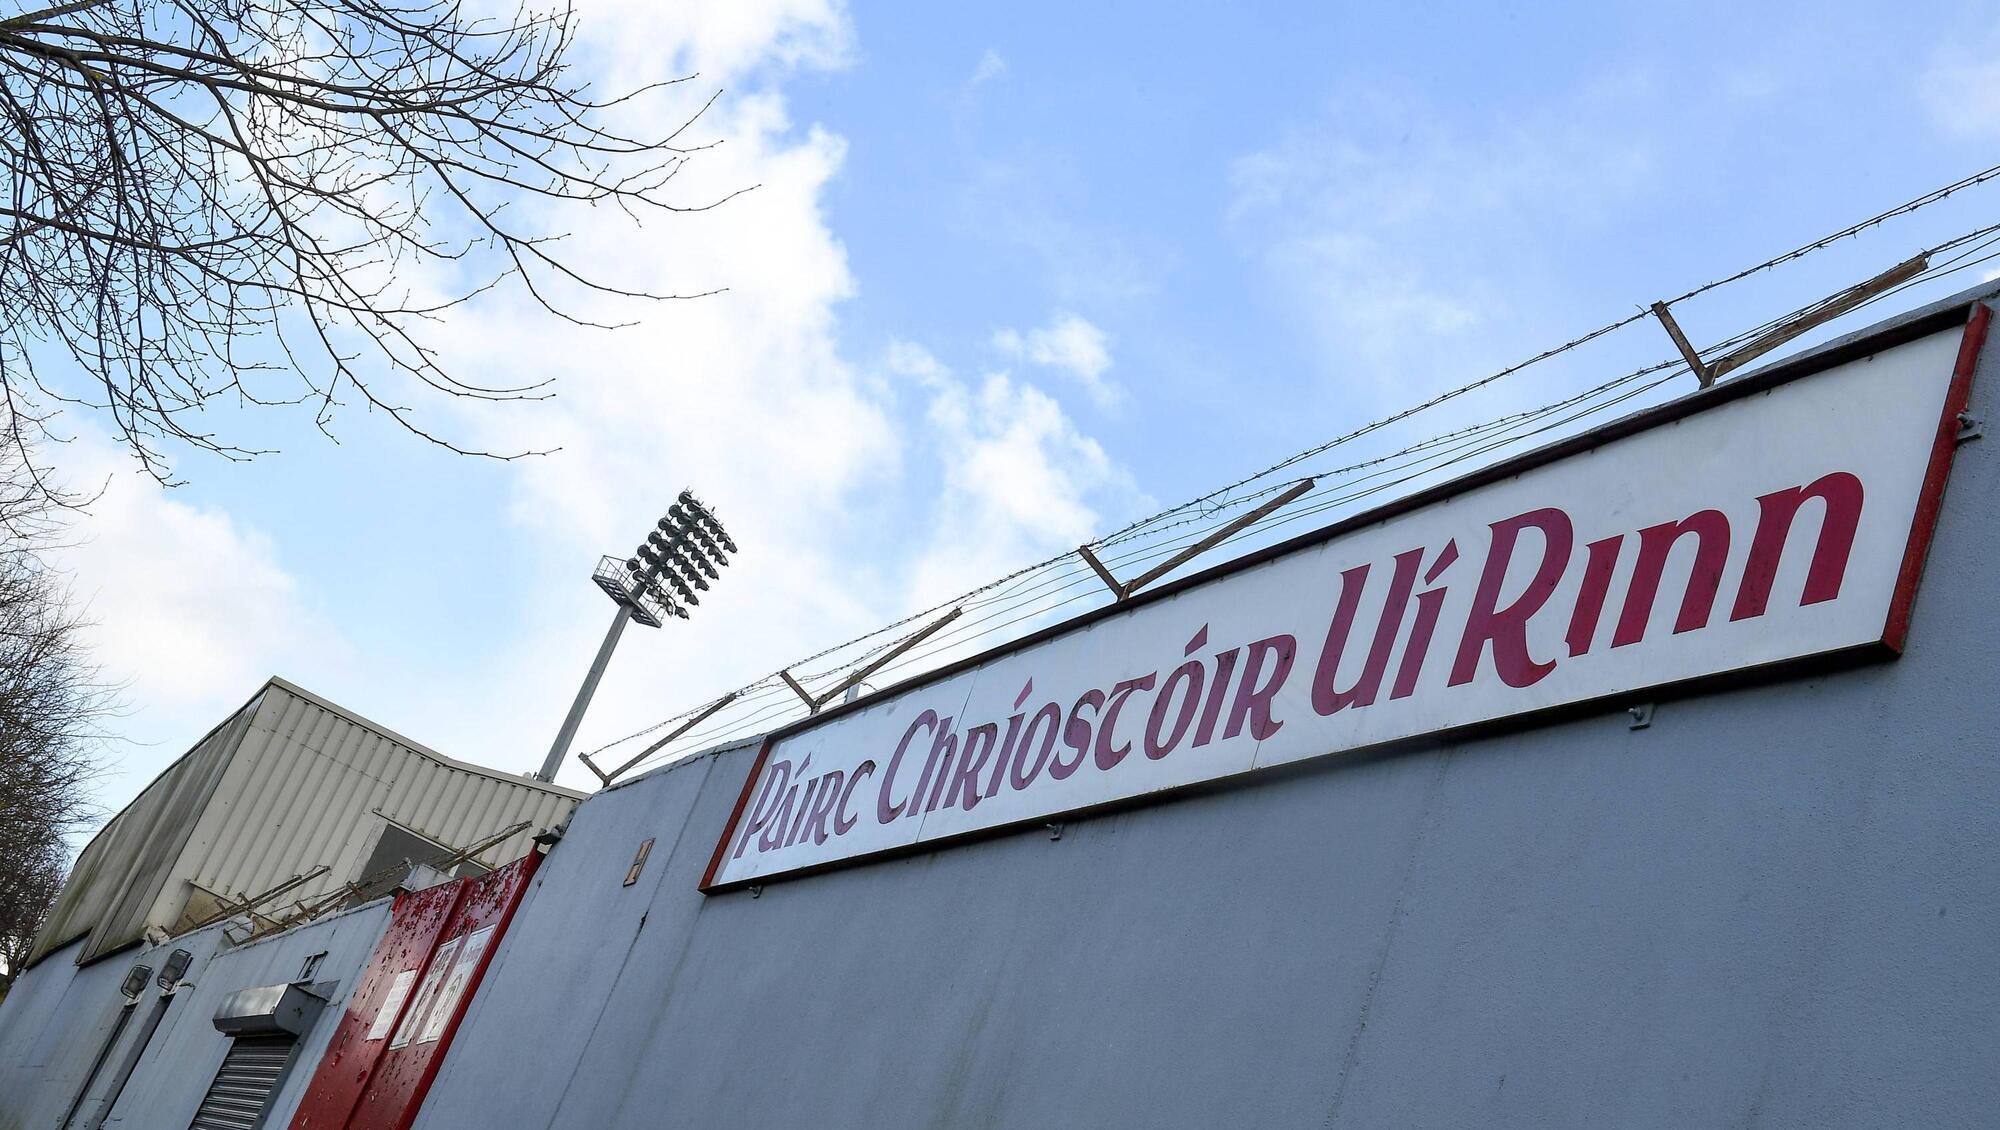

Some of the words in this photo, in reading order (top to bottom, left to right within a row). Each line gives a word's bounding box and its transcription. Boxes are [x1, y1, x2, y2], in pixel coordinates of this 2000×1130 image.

[733, 752, 876, 859] Páirc
[877, 622, 1297, 824] Chríostóir
[1311, 538, 1459, 716] Uí
[1447, 471, 1865, 688] Rinn
